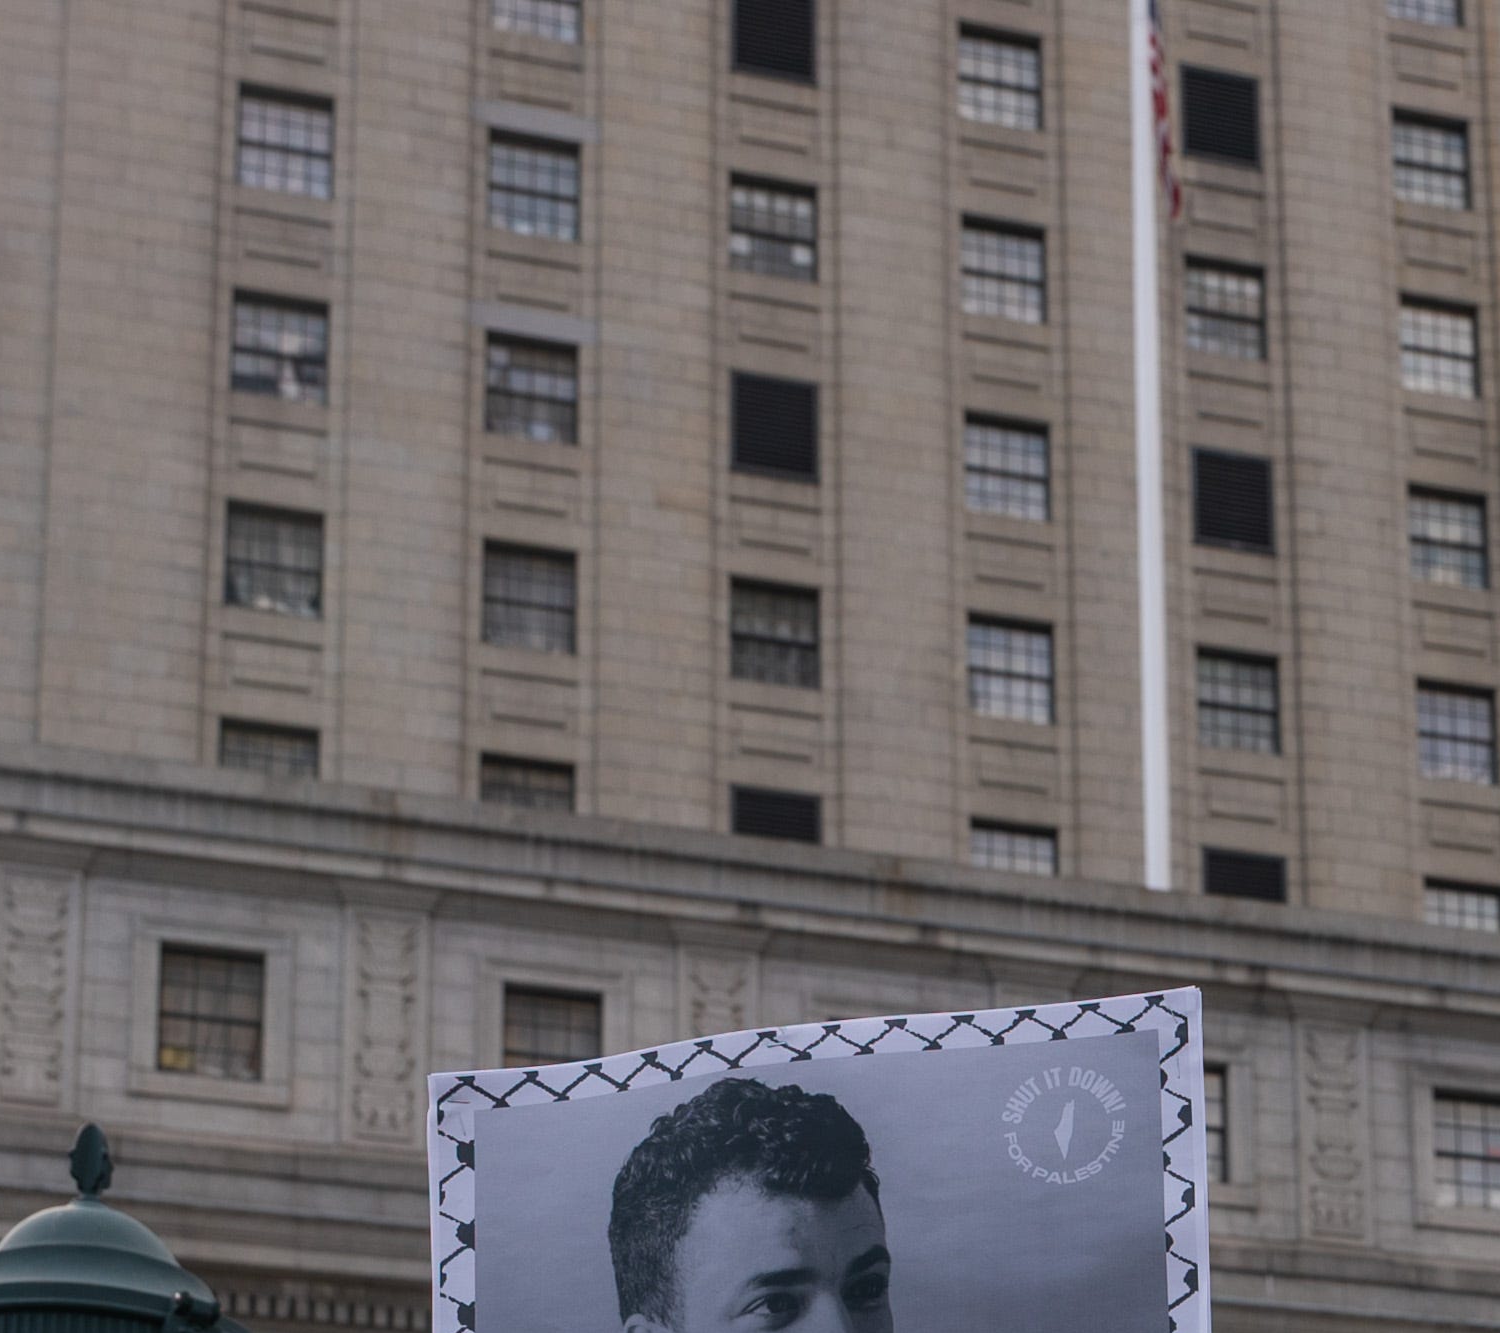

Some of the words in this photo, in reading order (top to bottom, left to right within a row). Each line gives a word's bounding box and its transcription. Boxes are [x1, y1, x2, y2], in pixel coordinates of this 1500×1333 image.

[1002, 1077, 1042, 1124] SHUT
[1043, 1067, 1061, 1089] IT
[1068, 1067, 1126, 1114] DOWN!
[1004, 1132, 1033, 1173] FOR
[1032, 1120, 1125, 1184] PALESTINE
